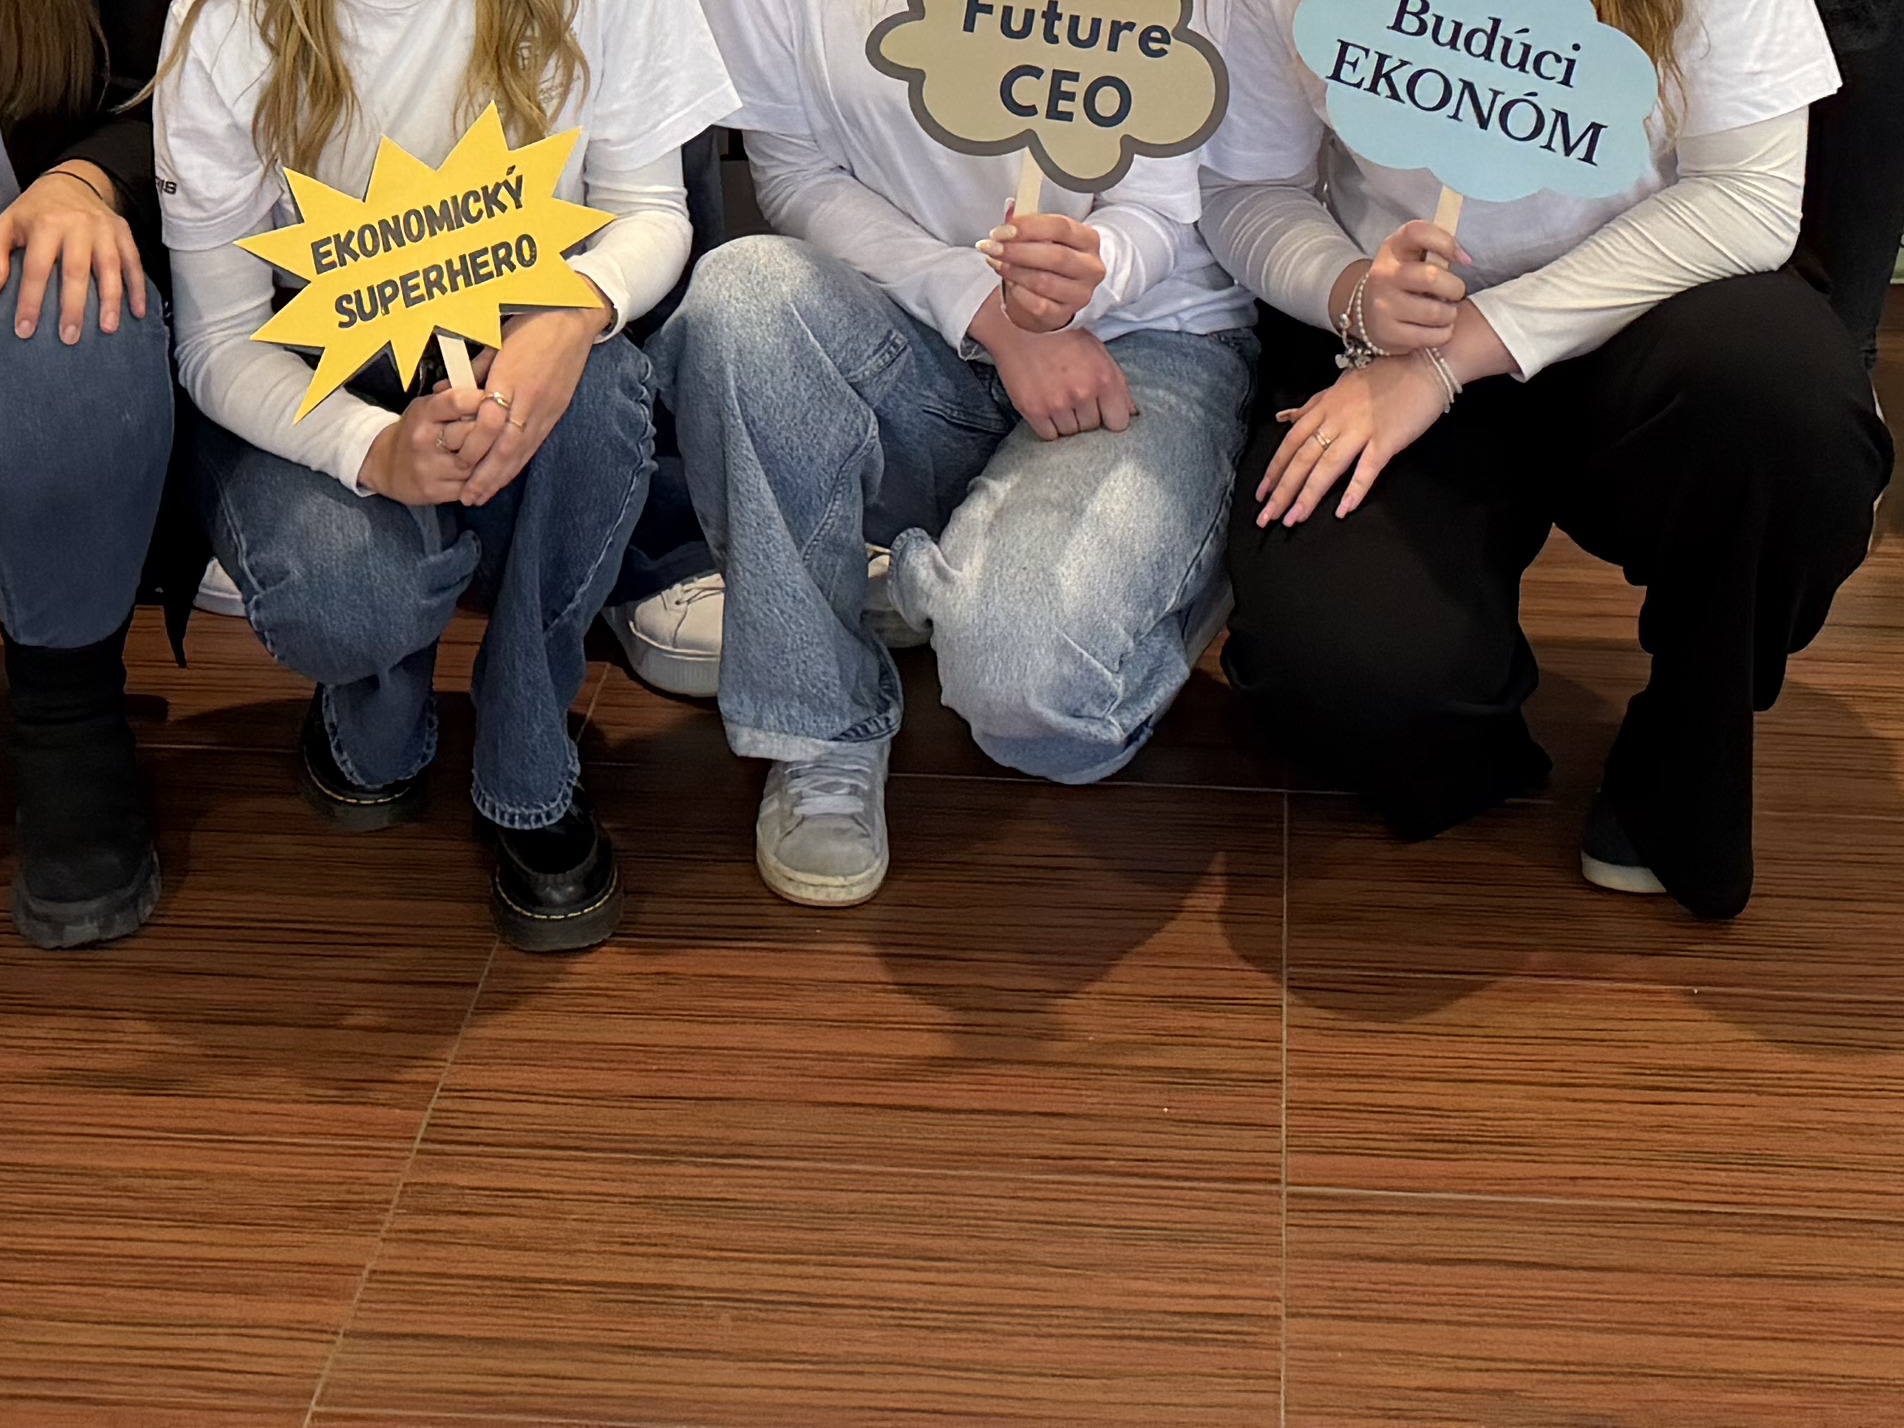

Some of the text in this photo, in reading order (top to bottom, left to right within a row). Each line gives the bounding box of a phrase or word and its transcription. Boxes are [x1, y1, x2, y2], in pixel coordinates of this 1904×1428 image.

[999, 64, 1132, 128] CEO
[1325, 38, 1609, 167] EKONÓM
[310, 164, 525, 275] EKONOMICKÝ
[334, 233, 538, 330] SUPERHERO
